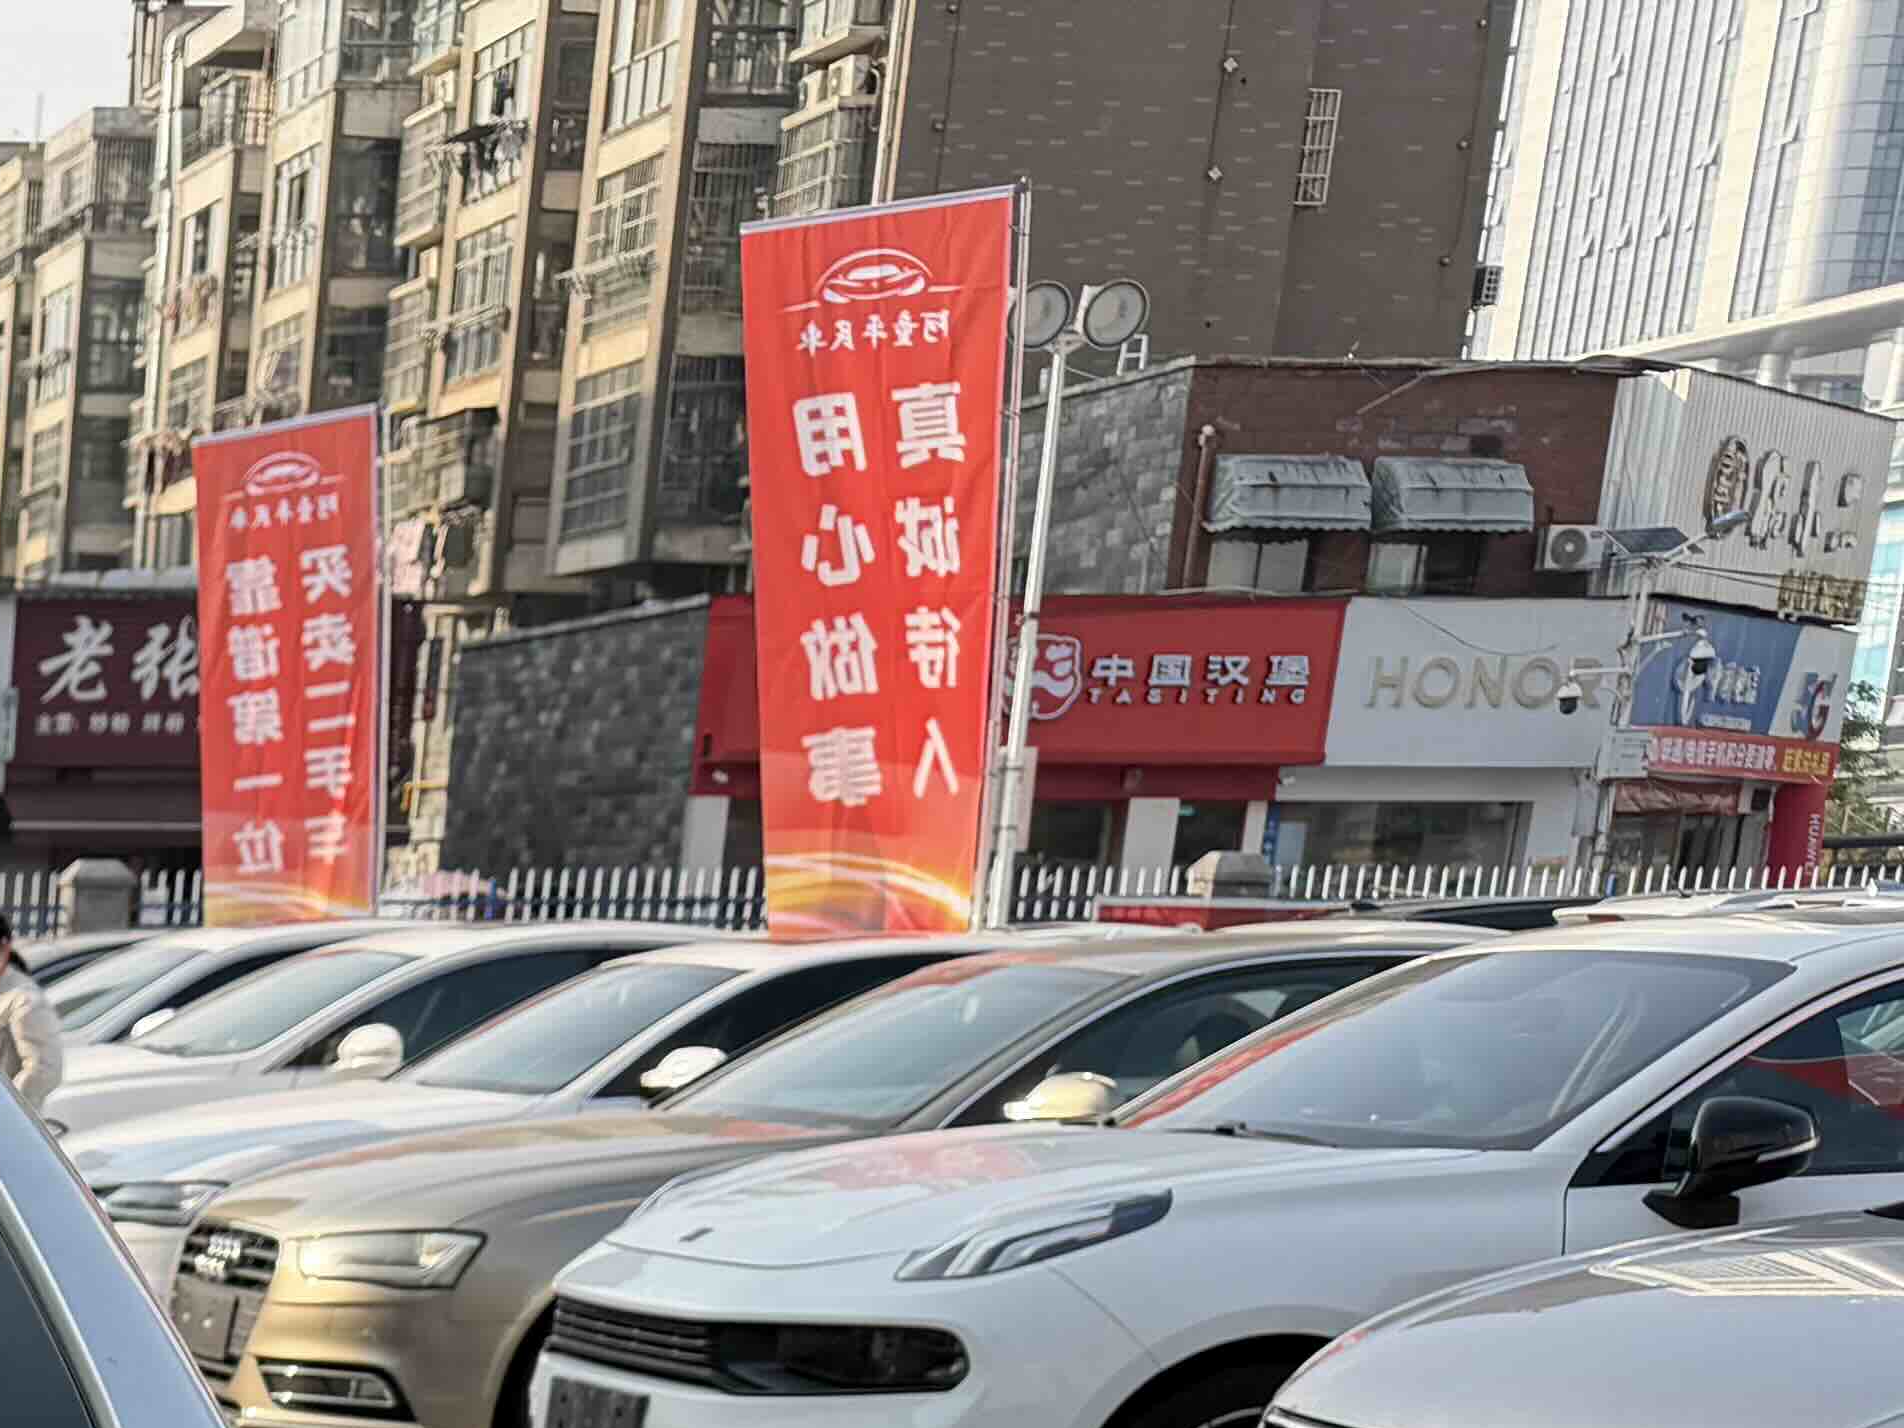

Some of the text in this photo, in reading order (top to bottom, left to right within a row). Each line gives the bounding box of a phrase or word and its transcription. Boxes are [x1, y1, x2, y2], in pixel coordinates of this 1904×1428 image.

[1091, 653, 1310, 689] 中国汉堡
[1365, 655, 1605, 710] HONOR
